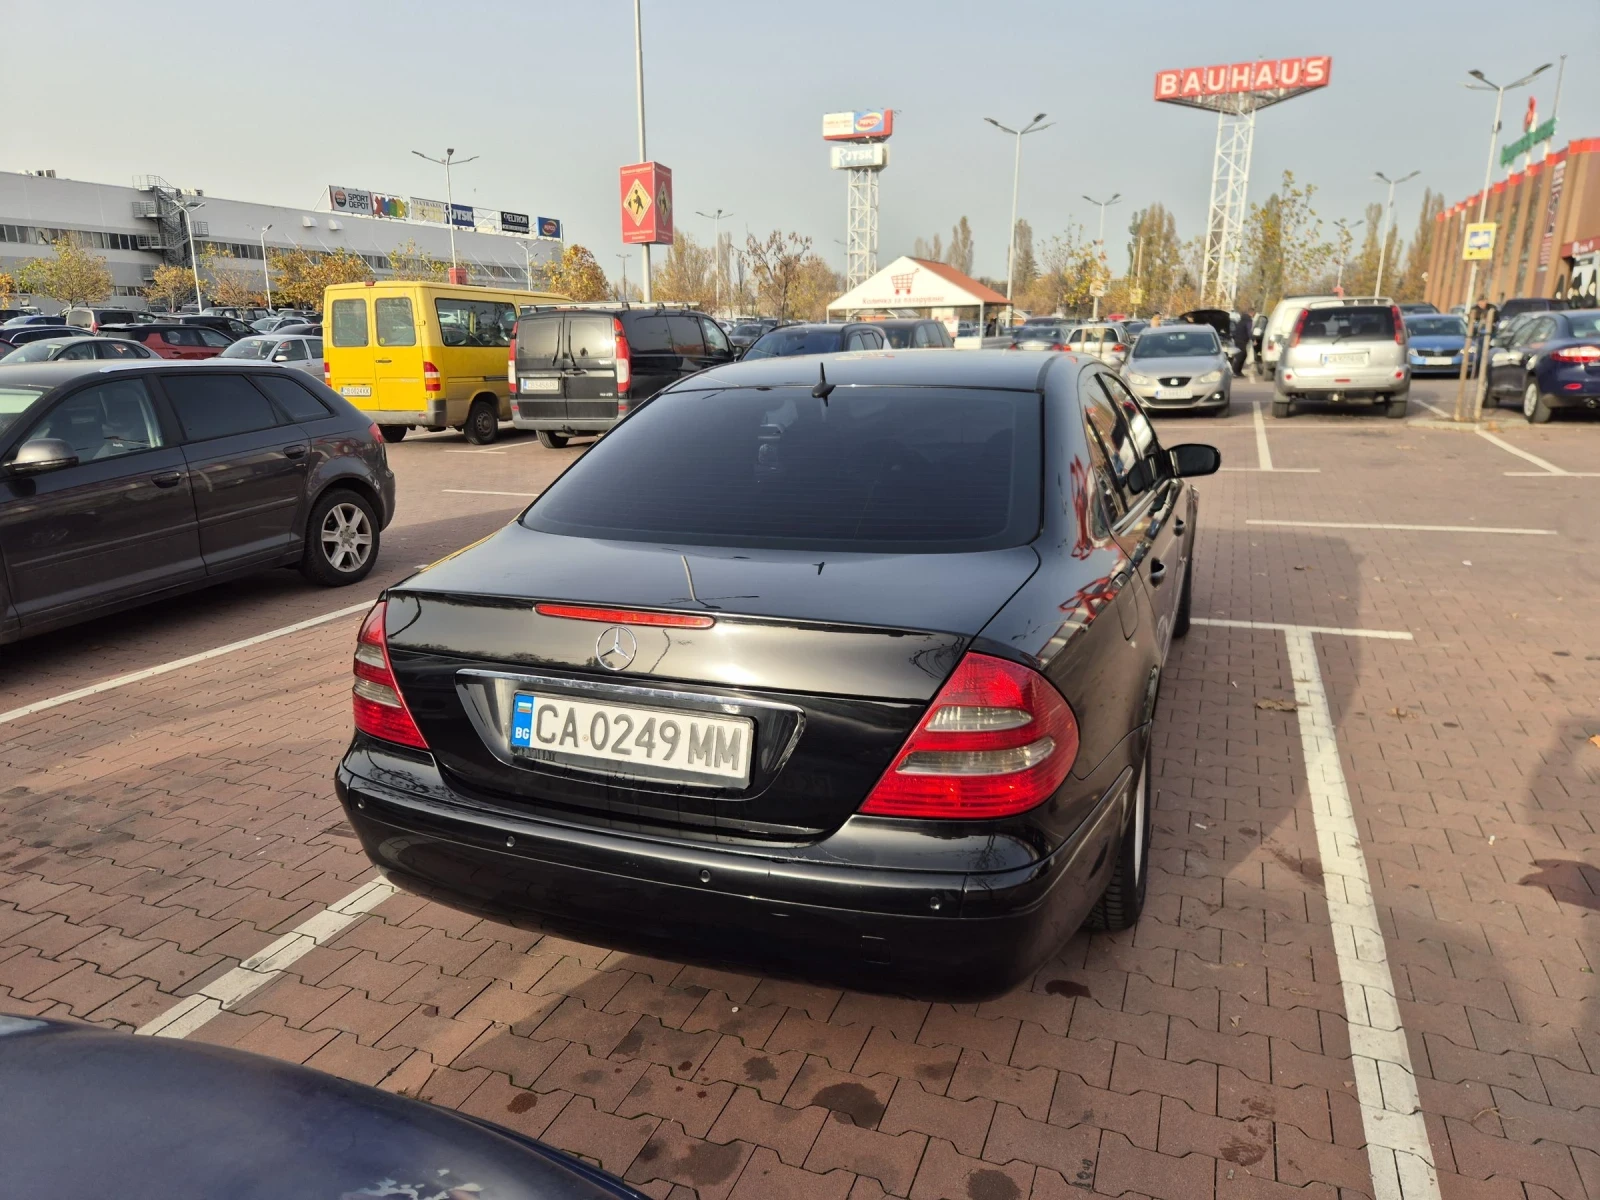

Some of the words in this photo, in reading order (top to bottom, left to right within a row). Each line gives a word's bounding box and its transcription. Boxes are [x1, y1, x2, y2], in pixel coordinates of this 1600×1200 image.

[1160, 60, 1324, 95] BAUHAUS
[846, 149, 873, 161] JYSK
[347, 193, 369, 203] SPORT
[348, 201, 369, 210] DEPOT
[452, 207, 474, 222] JYSK
[515, 727, 530, 740] BG
[535, 703, 579, 748] CA
[590, 710, 682, 761] 0249
[687, 722, 742, 771] MM
